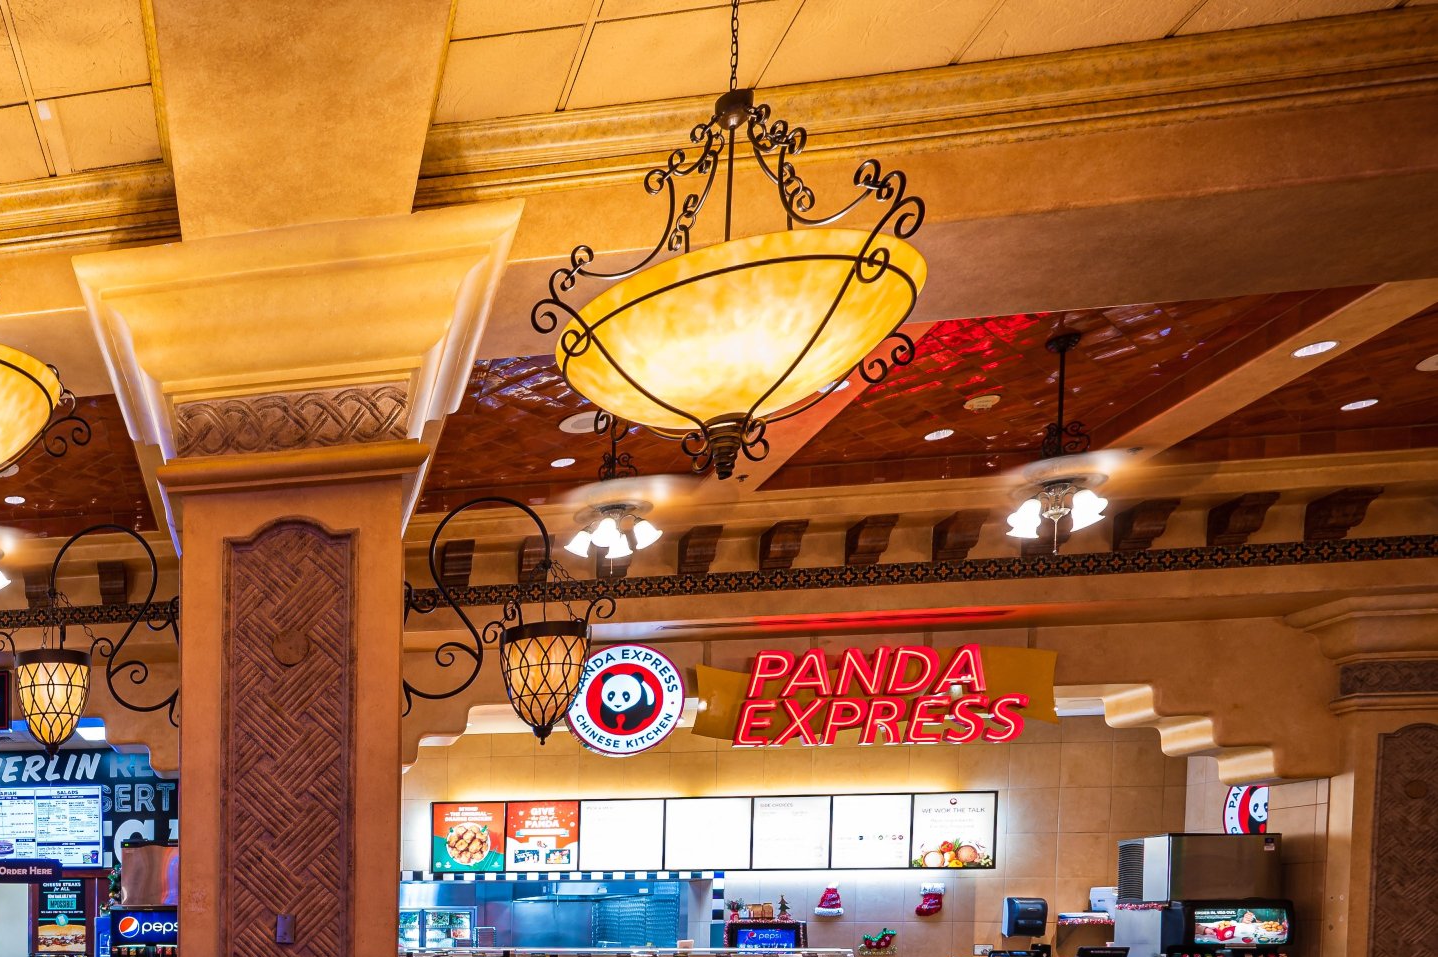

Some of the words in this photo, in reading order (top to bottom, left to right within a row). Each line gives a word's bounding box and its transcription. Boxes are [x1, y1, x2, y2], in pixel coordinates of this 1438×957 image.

[578, 652, 616, 694] ANDA
[621, 649, 678, 693] EXPRESS
[748, 643, 986, 698] PANDA
[576, 714, 620, 748] CHINESE
[626, 713, 674, 749] KITCHEN
[732, 692, 1029, 748] EXPRESS
[102, 783, 176, 813] SERT
[530, 807, 555, 816] GIVE
[524, 820, 560, 828] PANDA
[29, 866, 53, 875] HERE
[142, 922, 178, 935] peps
